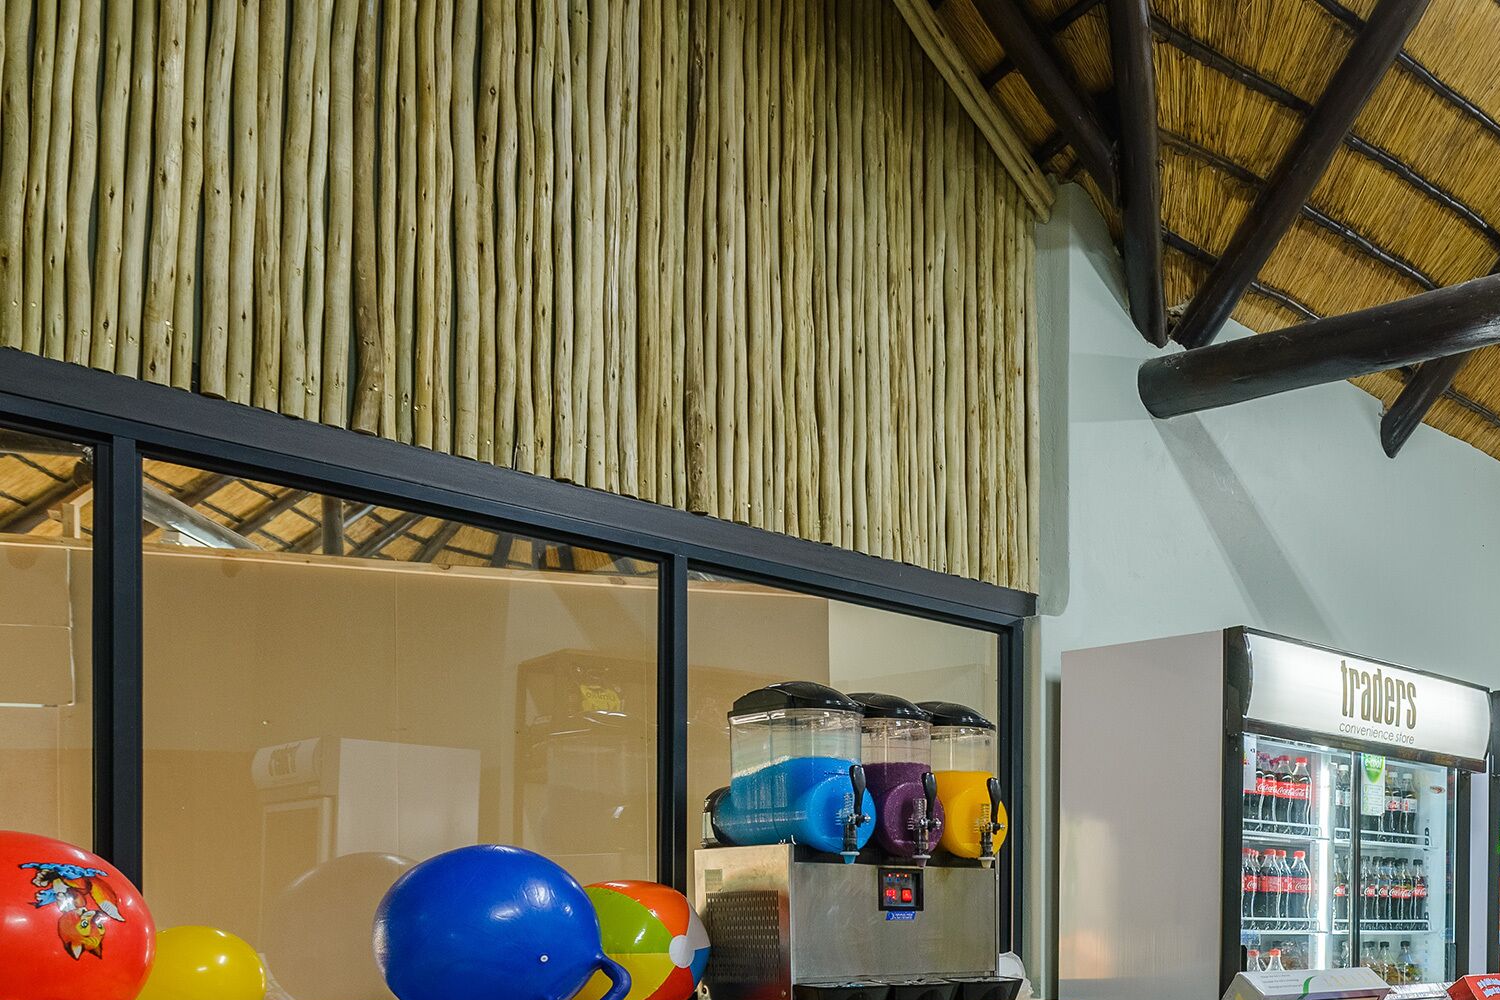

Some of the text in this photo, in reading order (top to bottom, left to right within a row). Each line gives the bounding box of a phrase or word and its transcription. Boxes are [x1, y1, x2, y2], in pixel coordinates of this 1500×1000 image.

[1340, 659, 1417, 730] traders
[1339, 721, 1415, 745] convenience store
